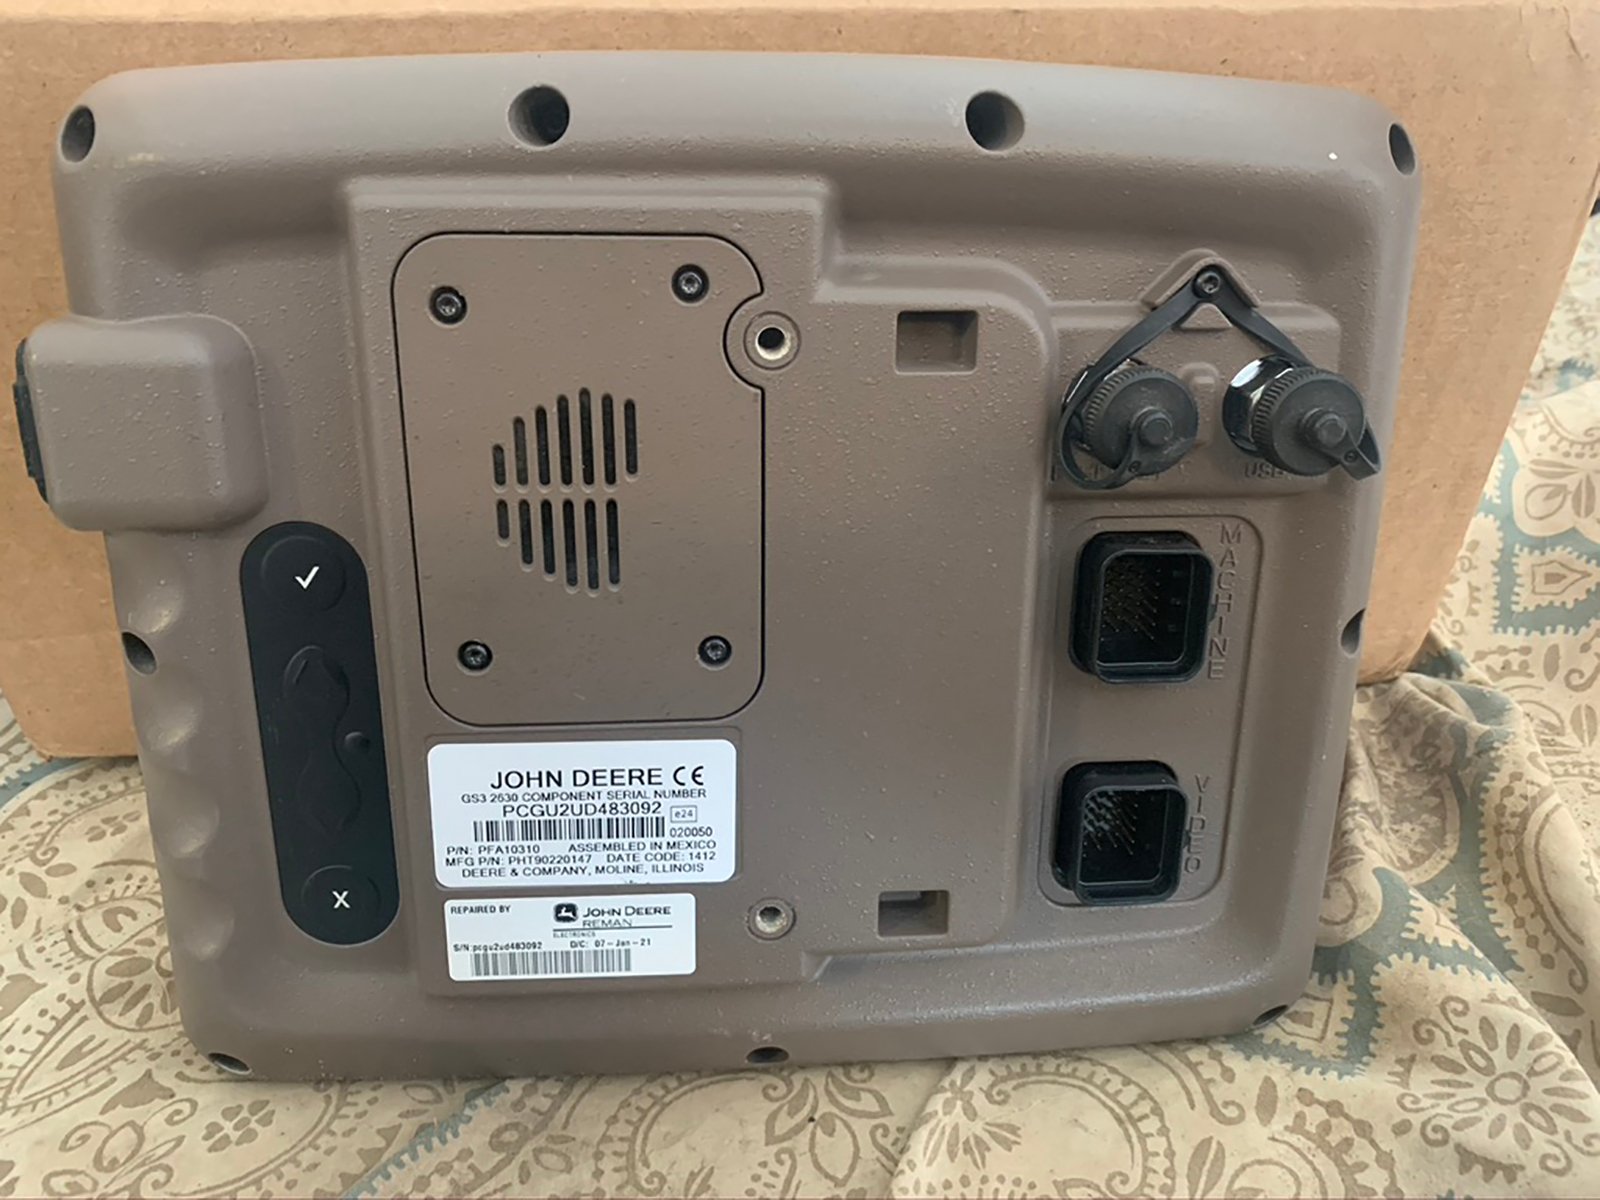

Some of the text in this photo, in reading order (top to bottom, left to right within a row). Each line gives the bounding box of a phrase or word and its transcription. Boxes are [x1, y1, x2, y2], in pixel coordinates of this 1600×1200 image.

[1207, 523, 1243, 679] MACHINE
[490, 770, 562, 790] JOHN
[572, 768, 662, 787] DEERE
[461, 793, 487, 803] GS3
[522, 790, 602, 802] COMPONENT
[606, 789, 650, 800] SERIAL
[654, 788, 707, 799] NUMBER
[502, 801, 662, 817] PCGU2UD483092
[674, 809, 694, 819] e24
[669, 827, 713, 837] 020050
[1184, 774, 1210, 874] VIDEO
[446, 839, 717, 855] P/N: PFA10310 ASSEMBLED IN MEXICO
[445, 856, 475, 867] MFG
[508, 854, 592, 865] PHT90220147
[606, 853, 640, 863] DATE
[644, 852, 685, 862] CODE:
[689, 851, 716, 860] 1412
[462, 862, 704, 878] DEERE & COMPANY, MOLINE, ILLINOIS
[450, 904, 511, 915] REPAIRED BY
[583, 906, 671, 918] JOHN DEERE
[582, 919, 632, 928] REMAN
